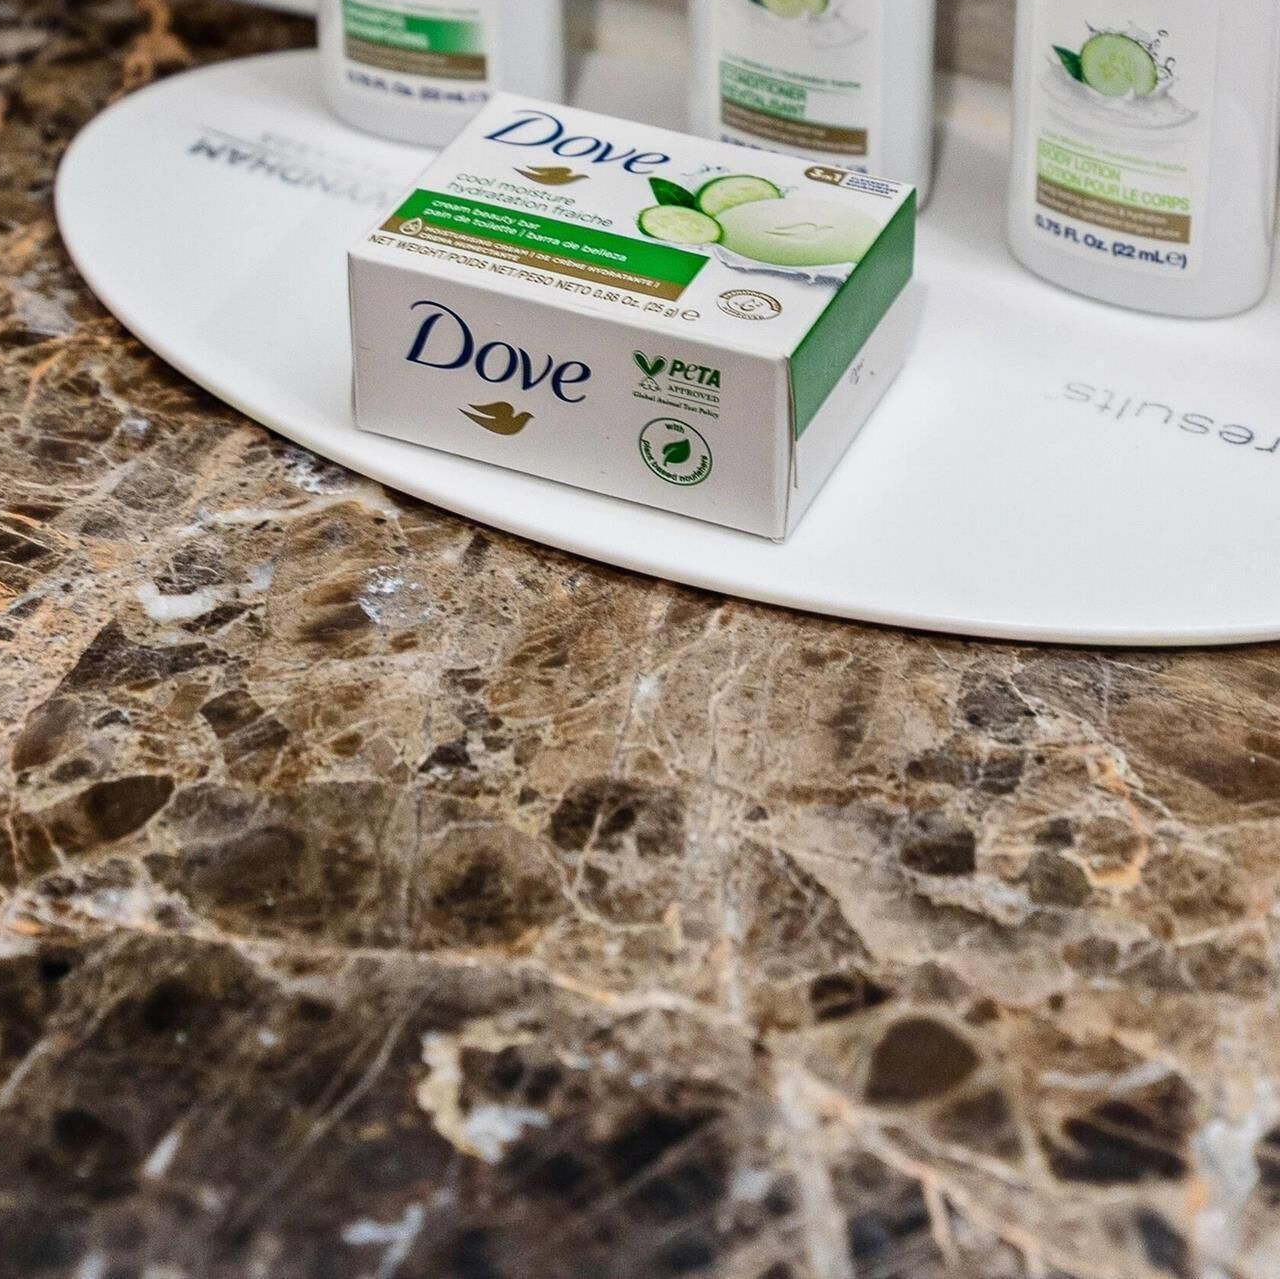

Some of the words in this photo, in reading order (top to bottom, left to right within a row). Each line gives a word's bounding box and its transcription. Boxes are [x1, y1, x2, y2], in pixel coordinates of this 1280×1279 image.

[483, 109, 671, 175] Dove
[446, 181, 549, 213] hydratation
[456, 172, 493, 188] cool
[498, 180, 577, 207] moisture
[1123, 186, 1138, 203] LE
[1140, 191, 1191, 211] CORPS
[431, 199, 471, 214] cream
[471, 207, 518, 225] beauty
[517, 217, 542, 230] bar
[422, 207, 452, 221] pain
[453, 212, 471, 224] de
[472, 216, 518, 236] toilette
[526, 231, 560, 246] barra
[562, 240, 581, 251] de
[582, 244, 629, 262] belleza
[368, 233, 396, 247] NET
[554, 278, 592, 295] NETO
[404, 299, 593, 404] Dove
[668, 384, 720, 403] APPROVED
[664, 422, 685, 434] with
